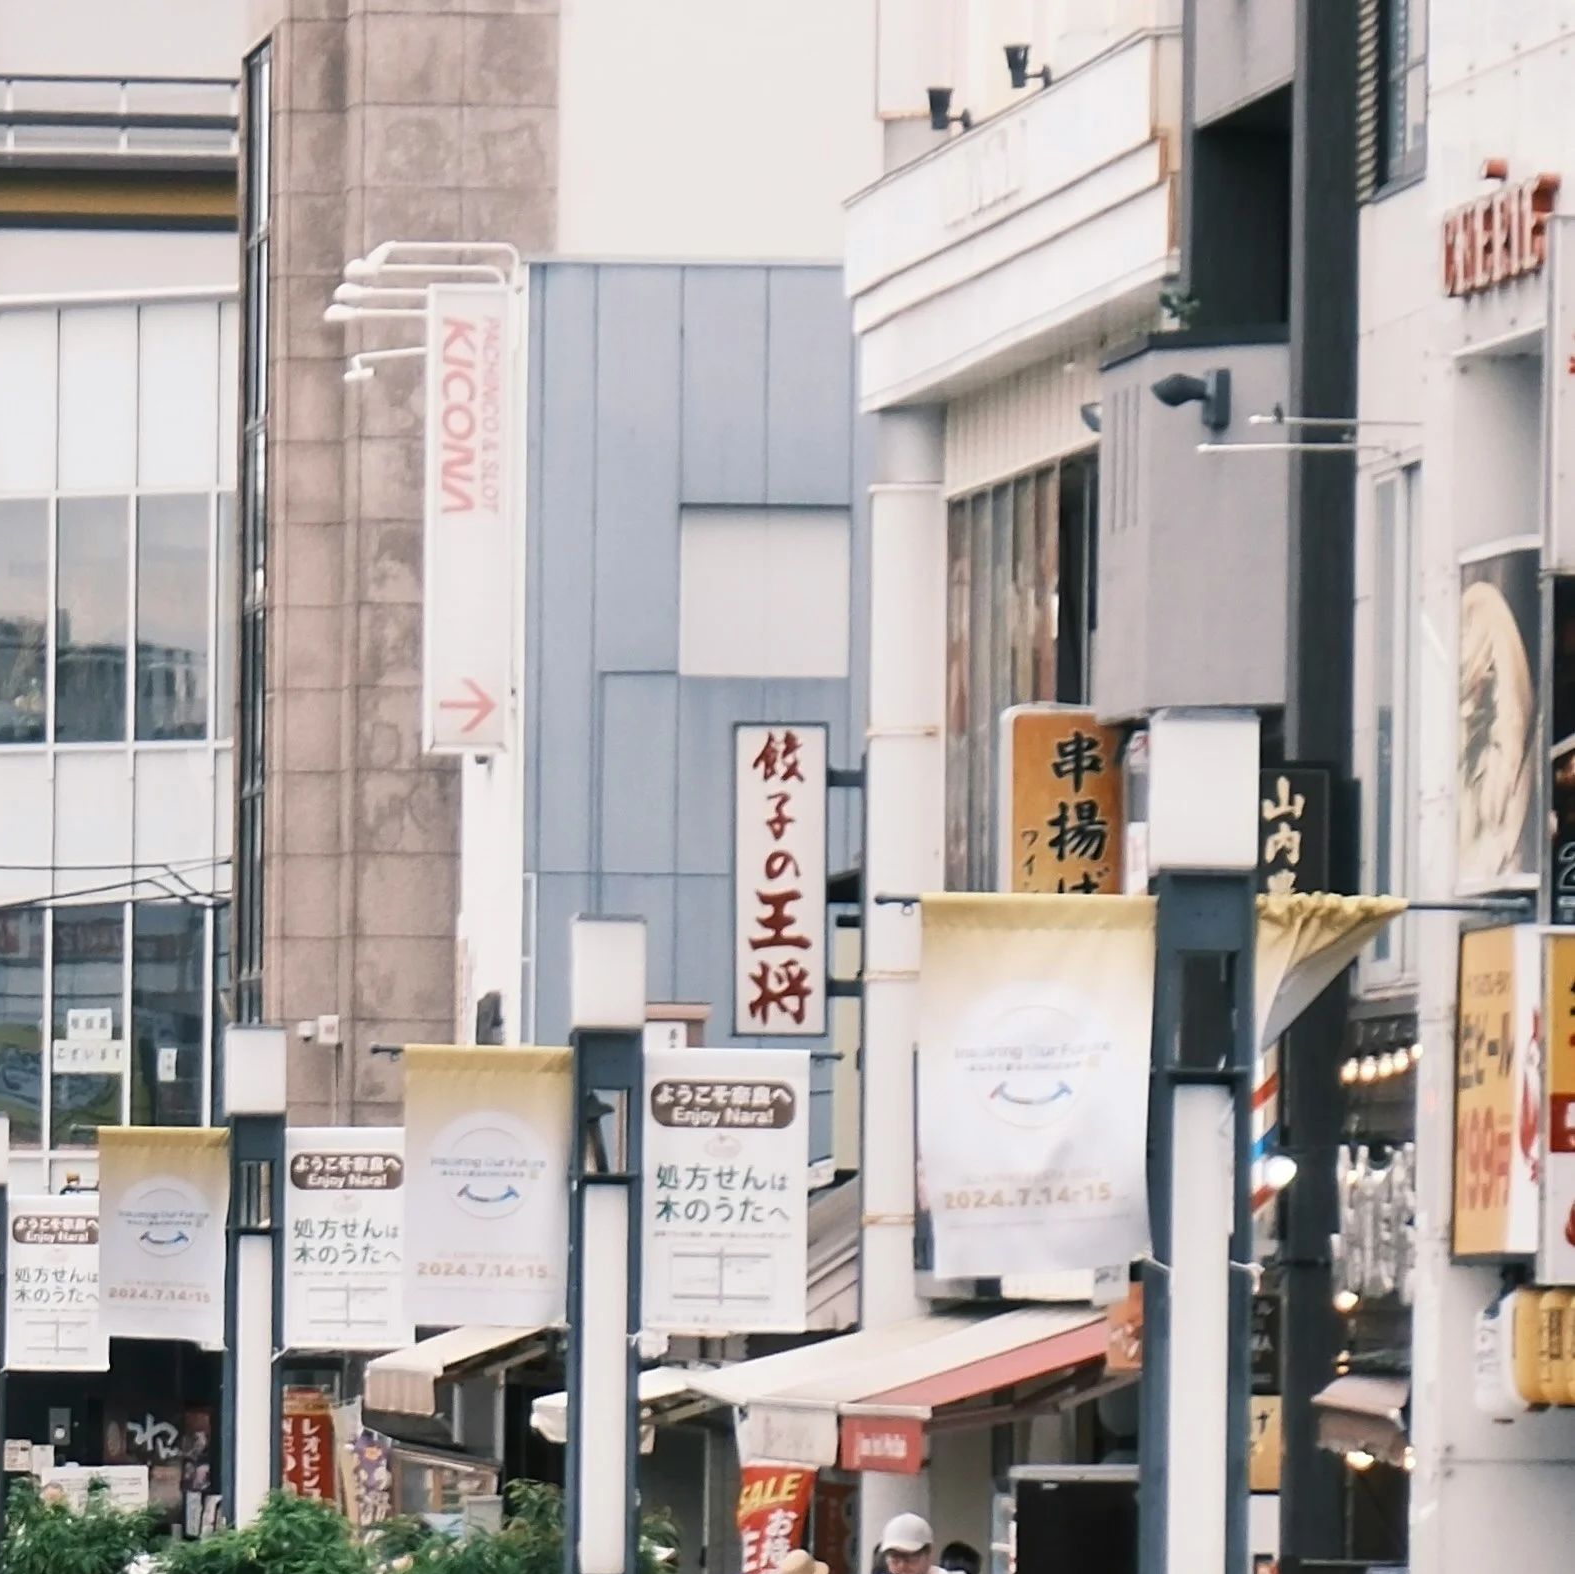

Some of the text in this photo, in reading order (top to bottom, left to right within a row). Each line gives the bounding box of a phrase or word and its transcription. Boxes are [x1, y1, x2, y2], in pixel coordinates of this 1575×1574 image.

[482, 460, 501, 514] SLOT
[749, 729, 814, 1026] 餃子の王将
[656, 1083, 793, 1107] ようこそ奈良へ
[672, 1107, 775, 1127] Enjoy Nara!
[306, 1173, 347, 1190] Enjoy
[656, 1163, 789, 1191] 処方せんは
[654, 1196, 791, 1224] 木のうたへ
[293, 1217, 400, 1240] 処方せんは
[293, 1242, 402, 1265] 木のうたへ
